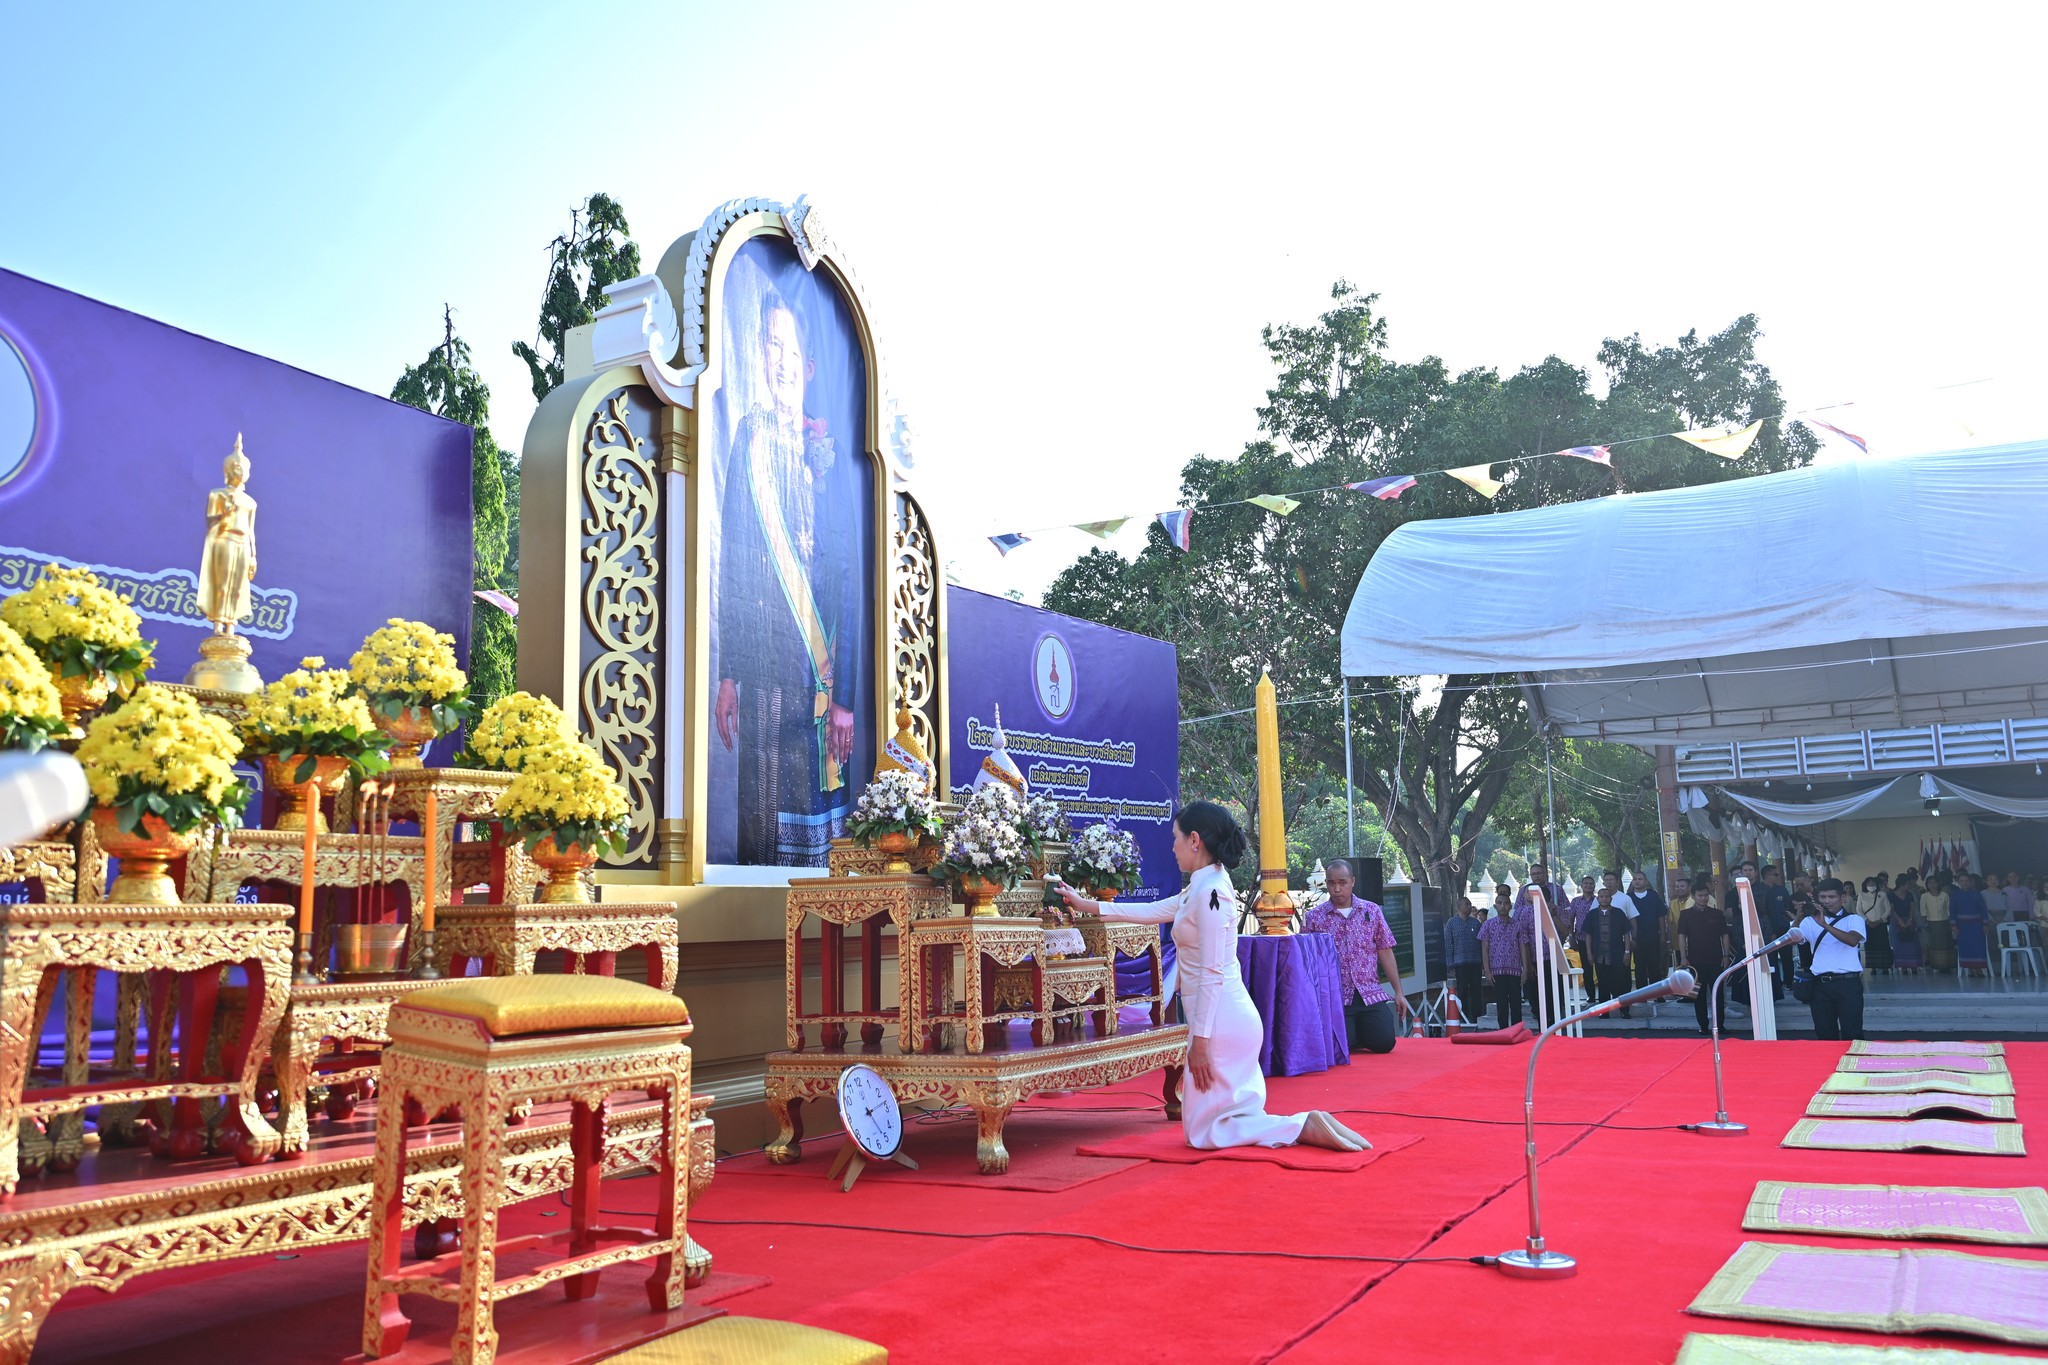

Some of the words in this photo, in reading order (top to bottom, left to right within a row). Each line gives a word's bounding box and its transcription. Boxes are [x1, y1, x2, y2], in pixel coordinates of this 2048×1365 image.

[969, 722, 1134, 763] โครงรบรรพชาสามเณรและบวชศีลจาริณี
[1031, 765, 1089, 787] เฉลิมพระเกียรติ
[1058, 796, 1120, 820] ระเทพรัตนราชสุดาฯ
[853, 1077, 863, 1088] 12
[866, 1079, 872, 1089] 1
[846, 1084, 854, 1095] 11
[875, 1087, 881, 1098] 2
[845, 1095, 852, 1106] 10
[883, 1100, 890, 1113] 3
[886, 1119, 892, 1129] 4
[866, 1137, 872, 1148] 7
[883, 1132, 889, 1143] 5
[875, 1138, 882, 1150] 6
